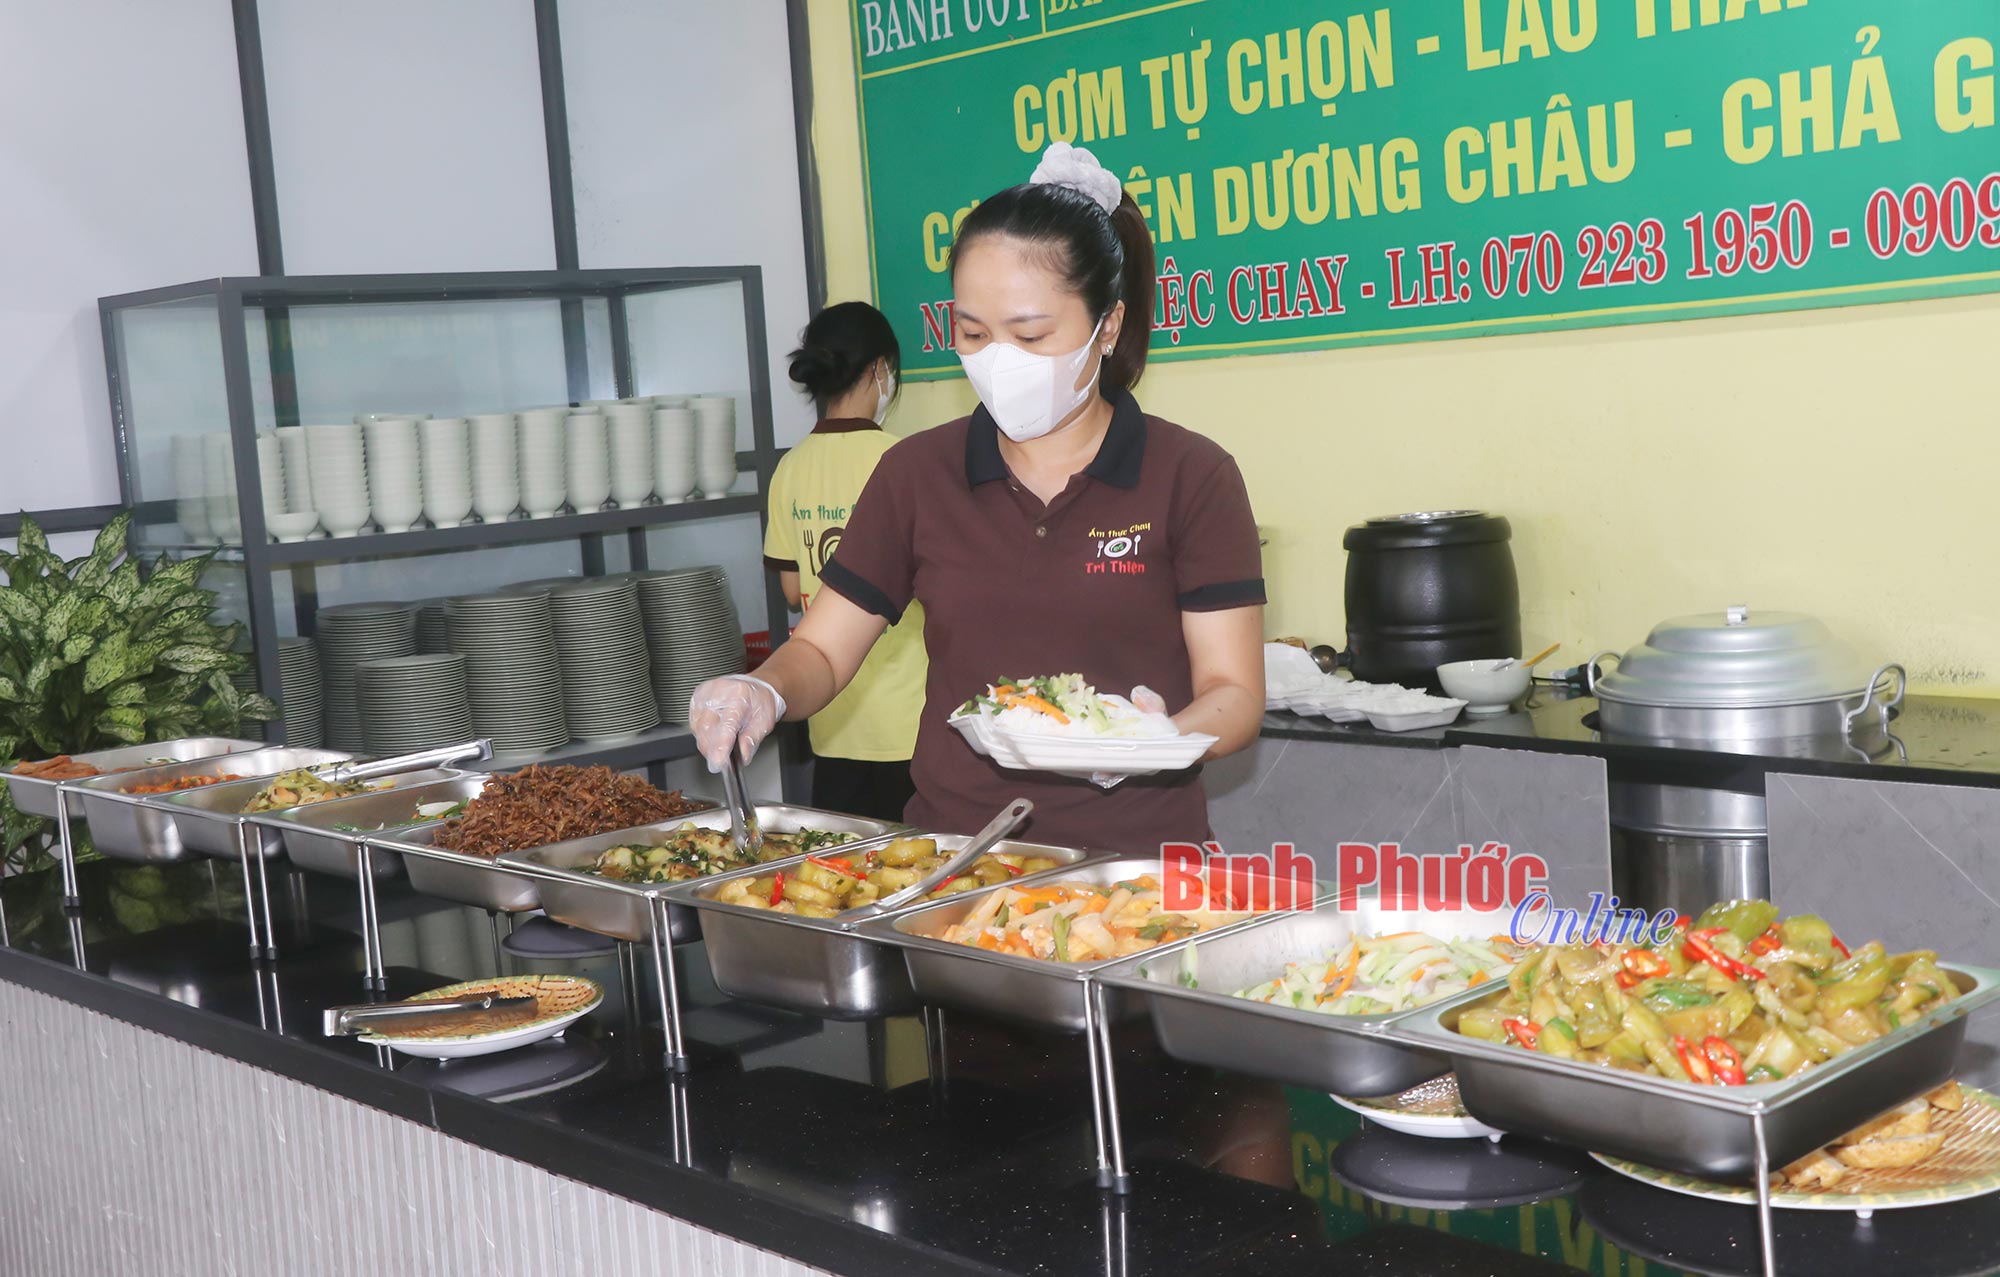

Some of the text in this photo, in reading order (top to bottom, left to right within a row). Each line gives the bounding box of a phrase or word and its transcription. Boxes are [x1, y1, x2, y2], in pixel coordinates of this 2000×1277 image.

[1014, 67, 1127, 153] CƠM
[1141, 40, 1211, 140] TỰ
[1227, 9, 1394, 116] CHỌN
[1417, 36, 1440, 55] -
[1214, 138, 1421, 235] DƯƠNG
[1444, 94, 1635, 203] CHÂU
[1665, 129, 1692, 148] -
[1722, 25, 1902, 165] CHẢ
[1227, 254, 1349, 324] CHAY
[1361, 281, 1376, 299] -
[1385, 241, 1471, 309] LH:
[1481, 230, 1565, 299] 070
[1577, 218, 1668, 289] 223
[1683, 199, 1814, 279] 1950
[1829, 227, 1851, 249] -
[1865, 172, 2000, 259] 0909
[1129, 522, 1151, 534] Chay
